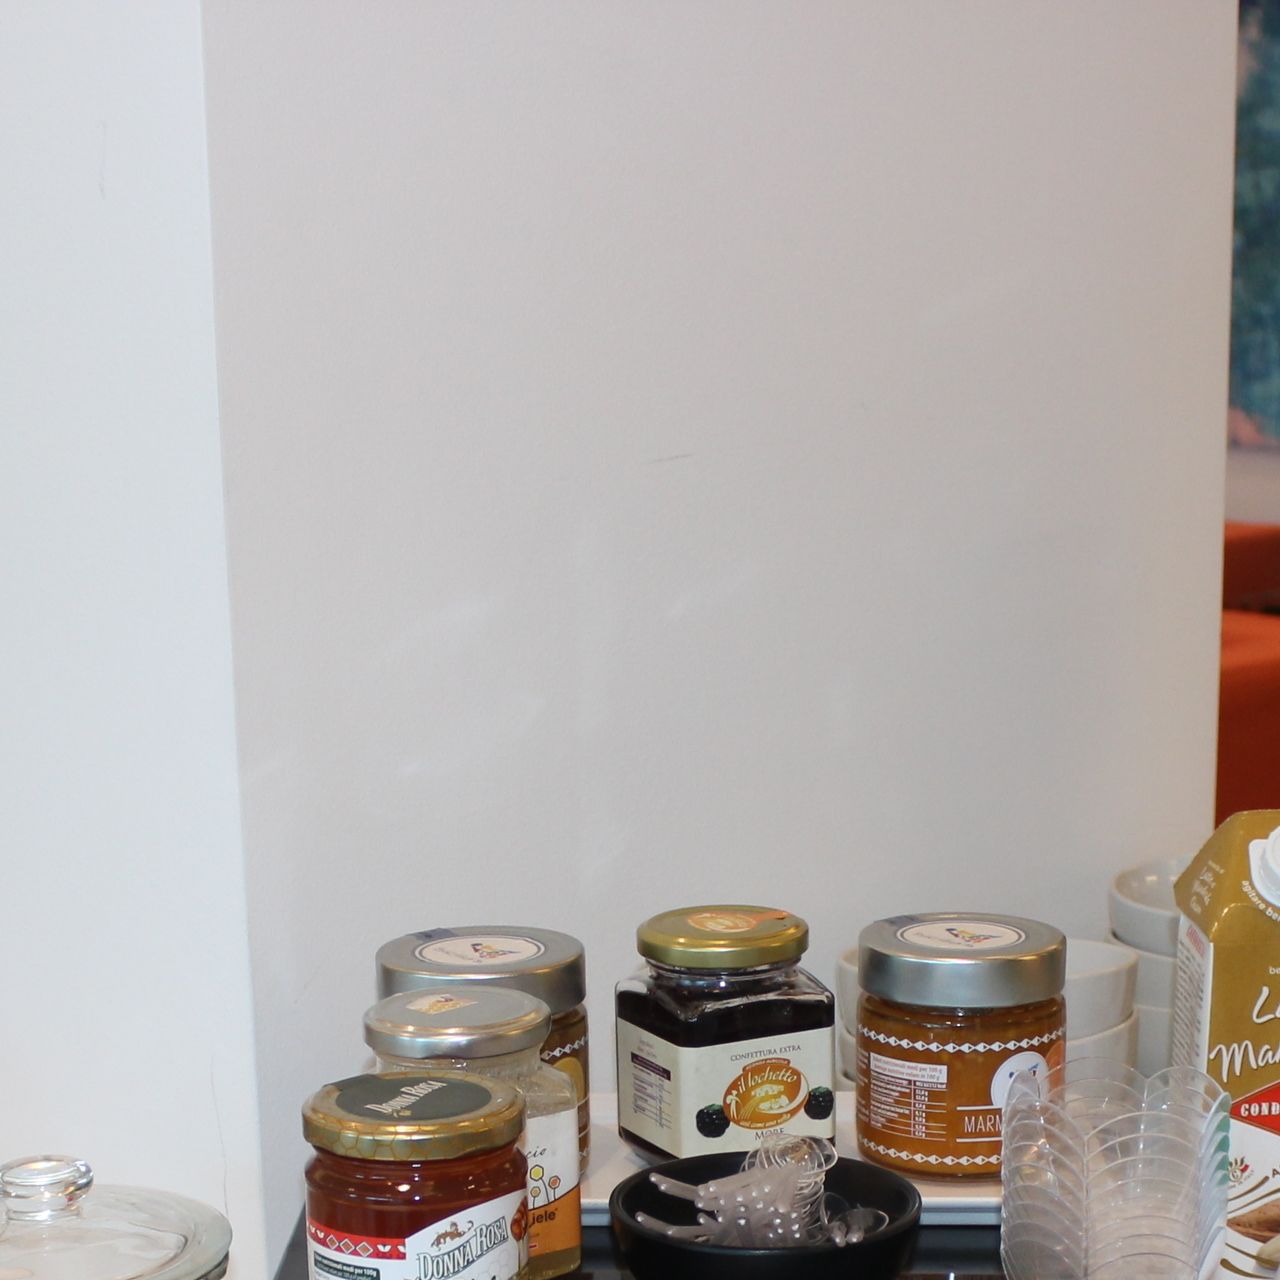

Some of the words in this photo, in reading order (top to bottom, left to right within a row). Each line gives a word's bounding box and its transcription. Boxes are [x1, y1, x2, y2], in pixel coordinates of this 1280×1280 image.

[1241, 880, 1266, 910] agitare
[730, 1048, 778, 1062] CONFETTURA
[779, 1044, 801, 1054] EXTRA
[738, 1076, 746, 1094] il
[475, 1216, 509, 1257] ROSA
